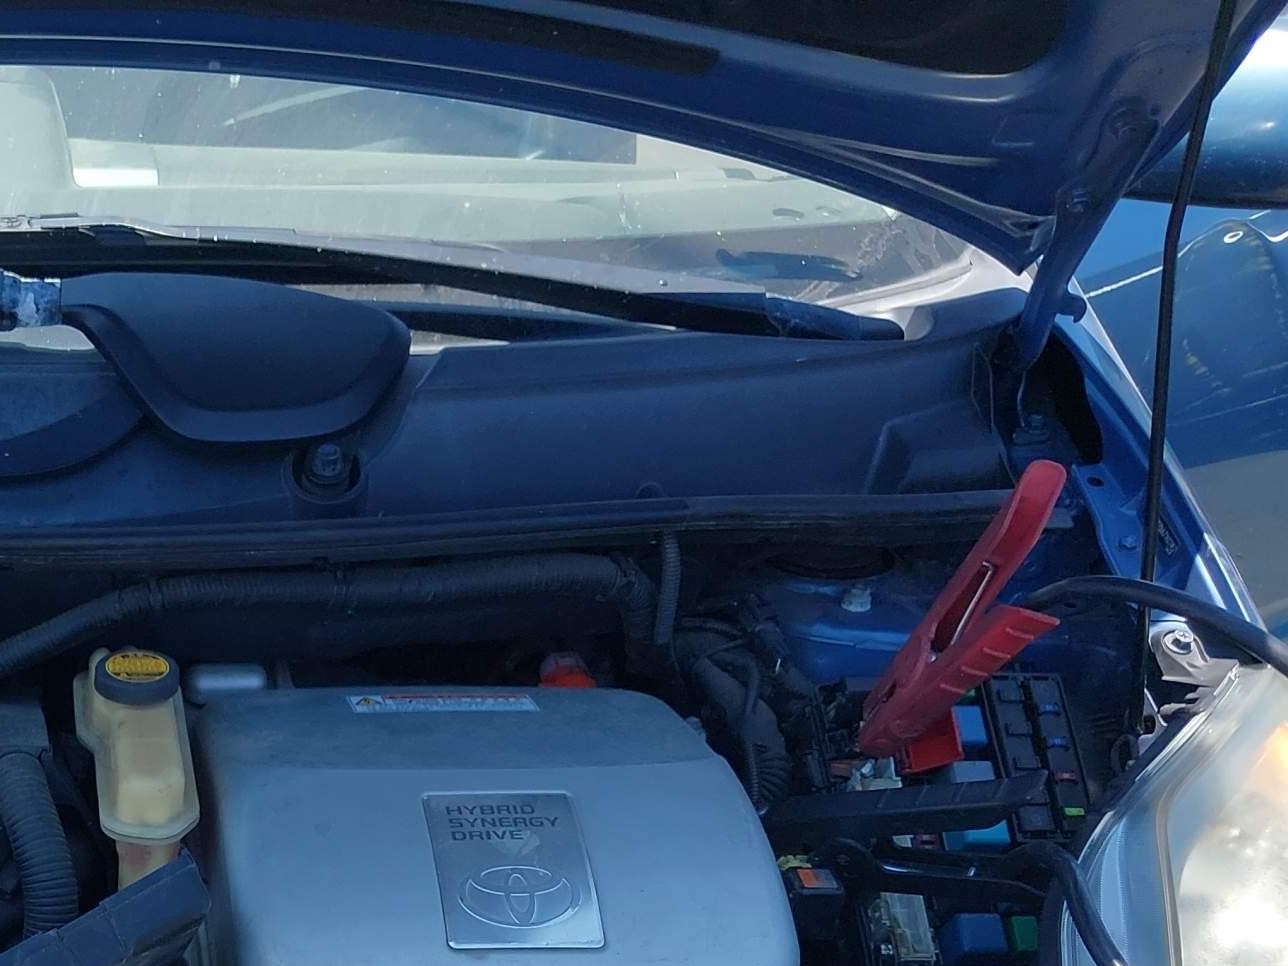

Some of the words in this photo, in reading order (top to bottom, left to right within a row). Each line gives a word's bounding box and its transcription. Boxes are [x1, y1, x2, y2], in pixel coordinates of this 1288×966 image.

[445, 804, 535, 816] HYBRID
[448, 816, 559, 828] SYNERGY
[451, 829, 525, 841] DRIVE
